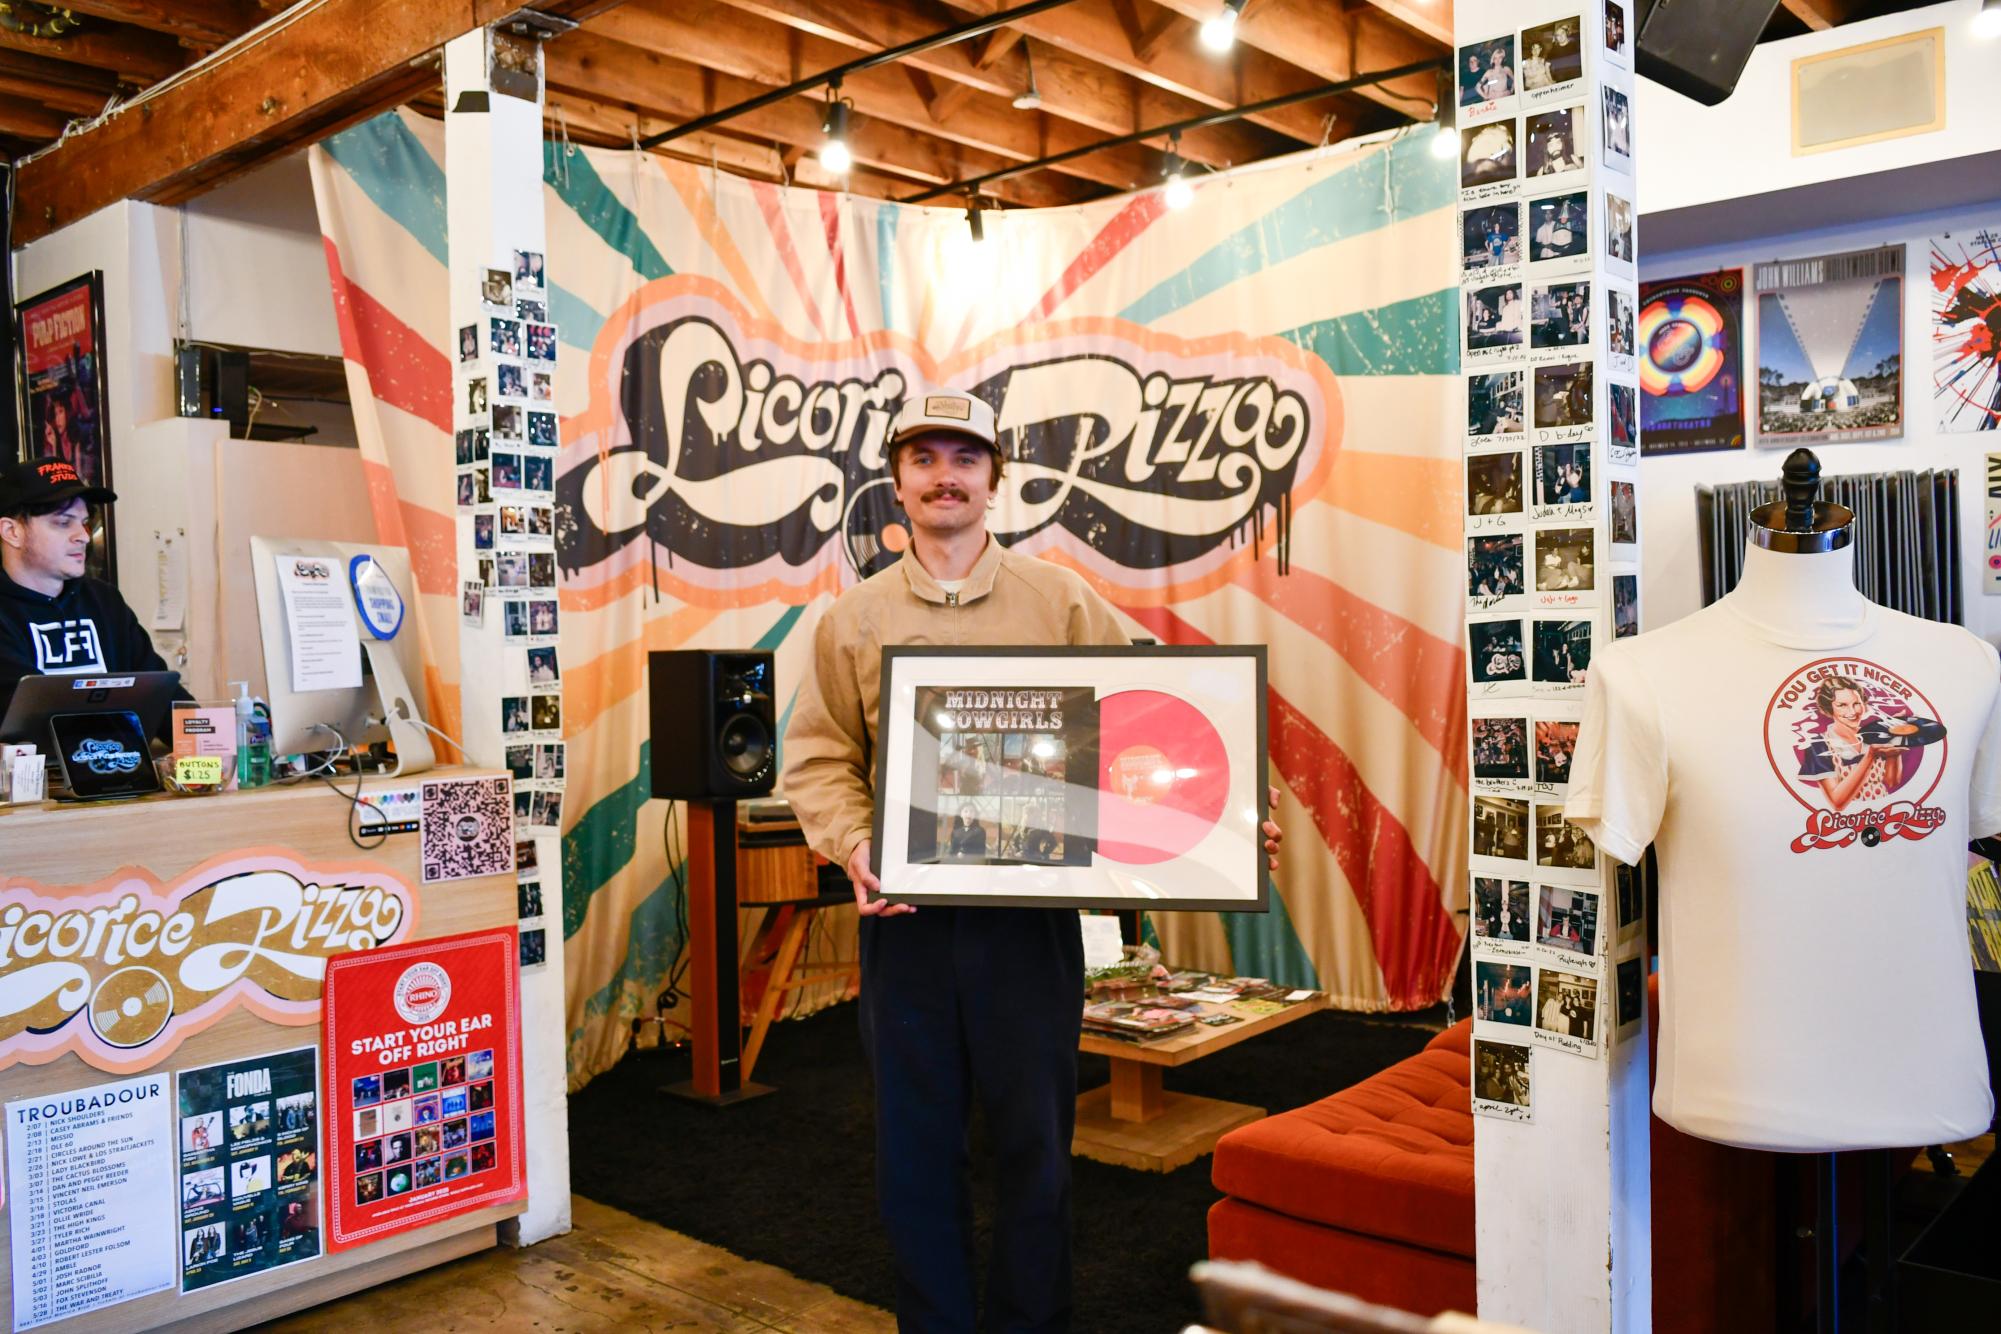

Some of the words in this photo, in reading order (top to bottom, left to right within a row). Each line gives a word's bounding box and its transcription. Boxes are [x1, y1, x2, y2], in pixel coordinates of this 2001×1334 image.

[1756, 264, 1780, 290] JOHN
[1781, 259, 1824, 288] WILLIAMS
[32, 319, 54, 348] PULP
[985, 354, 1307, 534] Pizza
[1777, 680, 1808, 710] YOU
[1806, 663, 1840, 684] GET
[1844, 663, 1859, 675] IT
[1864, 666, 1913, 700] NICER
[945, 690, 1063, 709] MIDNIGHT
[1800, 809, 1886, 849] Licorice
[1884, 801, 1946, 837] Pizza
[179, 871, 402, 992] Pizza
[409, 990, 438, 1002] RHINO
[351, 1031, 405, 1055] START
[409, 1022, 457, 1044] YOUR
[461, 1013, 492, 1032] EAR
[379, 1047, 412, 1065] OFF
[417, 1033, 469, 1057] RIGHT
[227, 1068, 271, 1099] FONDA
[17, 1084, 159, 1123] TROUBADOUR
[50, 1118, 66, 1126] NICK
[68, 1110, 104, 1122] SHOULDERS
[50, 1126, 70, 1134] CASEY
[72, 1119, 99, 1129] ABRAMS
[108, 1112, 133, 1122] FRIENDS
[50, 1133, 74, 1142] MISSIO
[52, 1149, 76, 1158] CIRCLES
[79, 1142, 106, 1152] AROUND
[121, 1136, 134, 1144] SUN
[69, 1154, 86, 1163] LOWE
[96, 1150, 107, 1158] LOS
[52, 1167, 68, 1175] LADY
[70, 1158, 106, 1171] BLACKBIRD
[66, 1169, 90, 1180] CACTUS
[92, 1162, 126, 1174] BLOSSOMS
[68, 1180, 82, 1188] AND
[84, 1175, 104, 1184] PEGGY
[106, 1169, 128, 1179] REEDER
[53, 1188, 80, 1199] VINCENT
[97, 1178, 127, 1189] EMERSON
[53, 1197, 77, 1207] STOLAS
[53, 1204, 82, 1215] VICTORIA
[54, 1215, 71, 1224] OLLIE
[68, 1220, 84, 1228] HIGH
[86, 1214, 105, 1224] KINGS
[54, 1231, 72, 1239] TYLER
[54, 1237, 82, 1248] MARTHA
[84, 1226, 125, 1240] WAINWRIGHT
[32, 1262, 46, 1270] 4/10
[55, 1253, 79, 1264] ROBERT
[82, 1247, 103, 1258] LESTER
[105, 1240, 130, 1251] FOLSOM
[55, 1243, 89, 1256] GOLDFORD
[32, 1278, 47, 1286] 5/01
[56, 1272, 72, 1280] JOSH
[75, 1264, 101, 1275] RADNOR
[55, 1262, 77, 1272] AMBLE
[56, 1279, 74, 1288] MARC
[77, 1272, 102, 1283] SCIBILIA
[56, 1287, 74, 1297] JOHN
[76, 1278, 108, 1290] SPLITHOFF
[56, 1304, 67, 1312] THE
[70, 1299, 84, 1308] WAR
[102, 1289, 123, 1300] TREATY
[70, 1286, 106, 1300] STEVENSON
